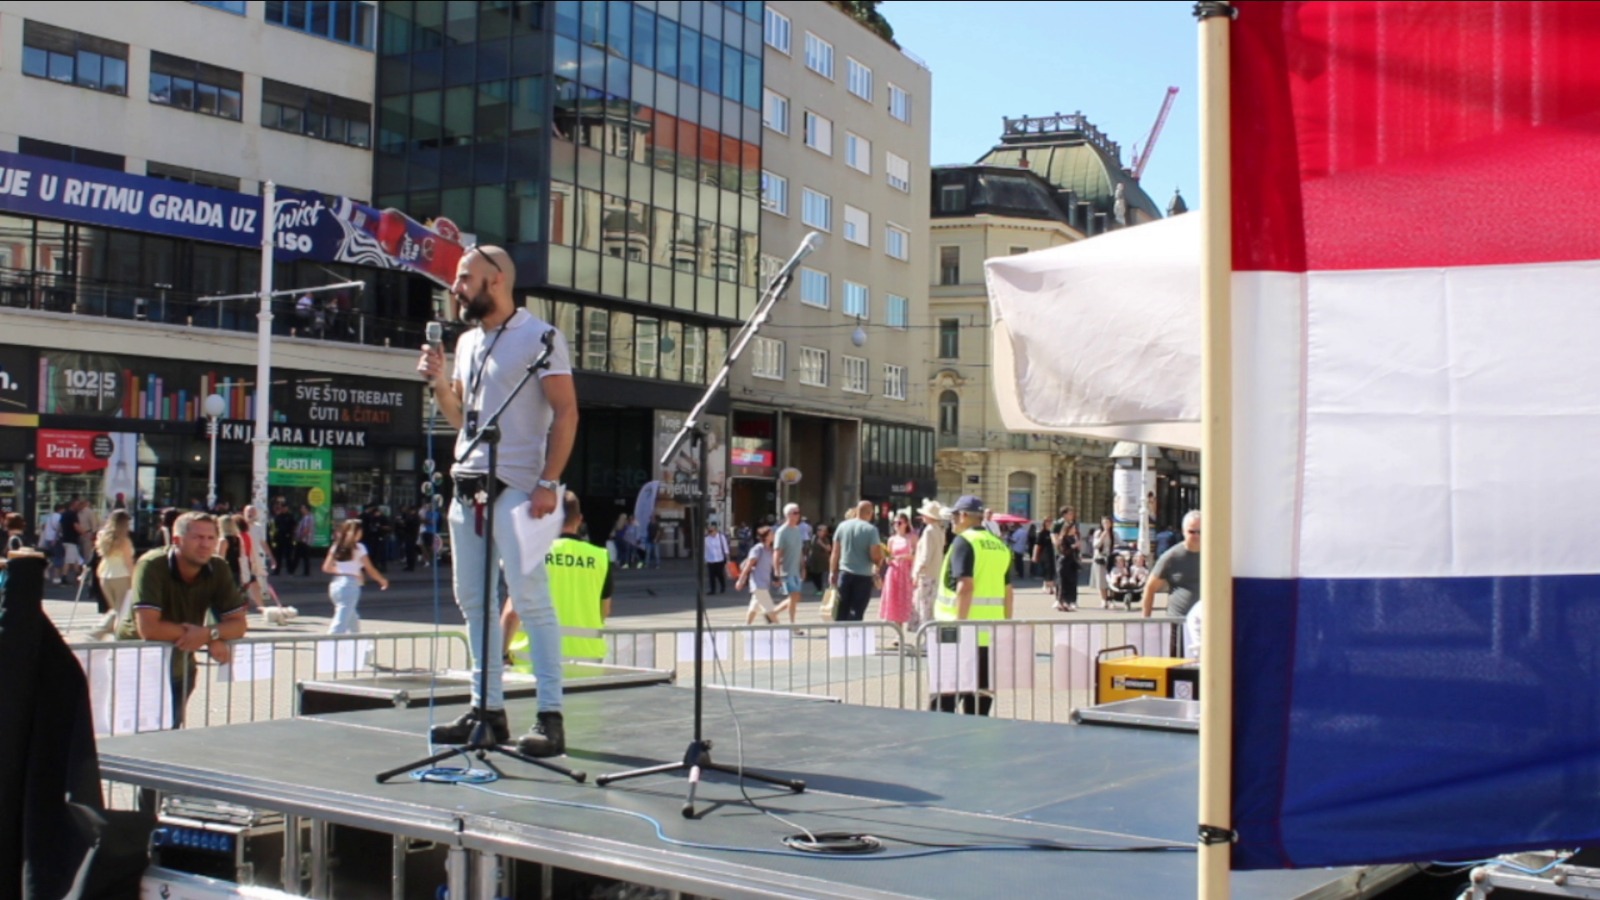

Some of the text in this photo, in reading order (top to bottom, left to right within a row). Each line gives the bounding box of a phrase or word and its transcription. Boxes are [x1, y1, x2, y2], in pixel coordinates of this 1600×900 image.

[39, 173, 59, 202] U
[63, 180, 144, 215] RITMU
[149, 193, 224, 229] GRADA
[230, 207, 257, 233] UZ
[272, 198, 325, 234] Twist
[295, 383, 404, 407] SVE ŠTO TREBATE
[309, 402, 390, 423] ČUTI & ČITATI
[222, 423, 366, 448] KNJARA LJEVAK
[45, 443, 86, 460] Pariz
[276, 458, 322, 471] PUSTI IH
[544, 552, 596, 569] REDAR
